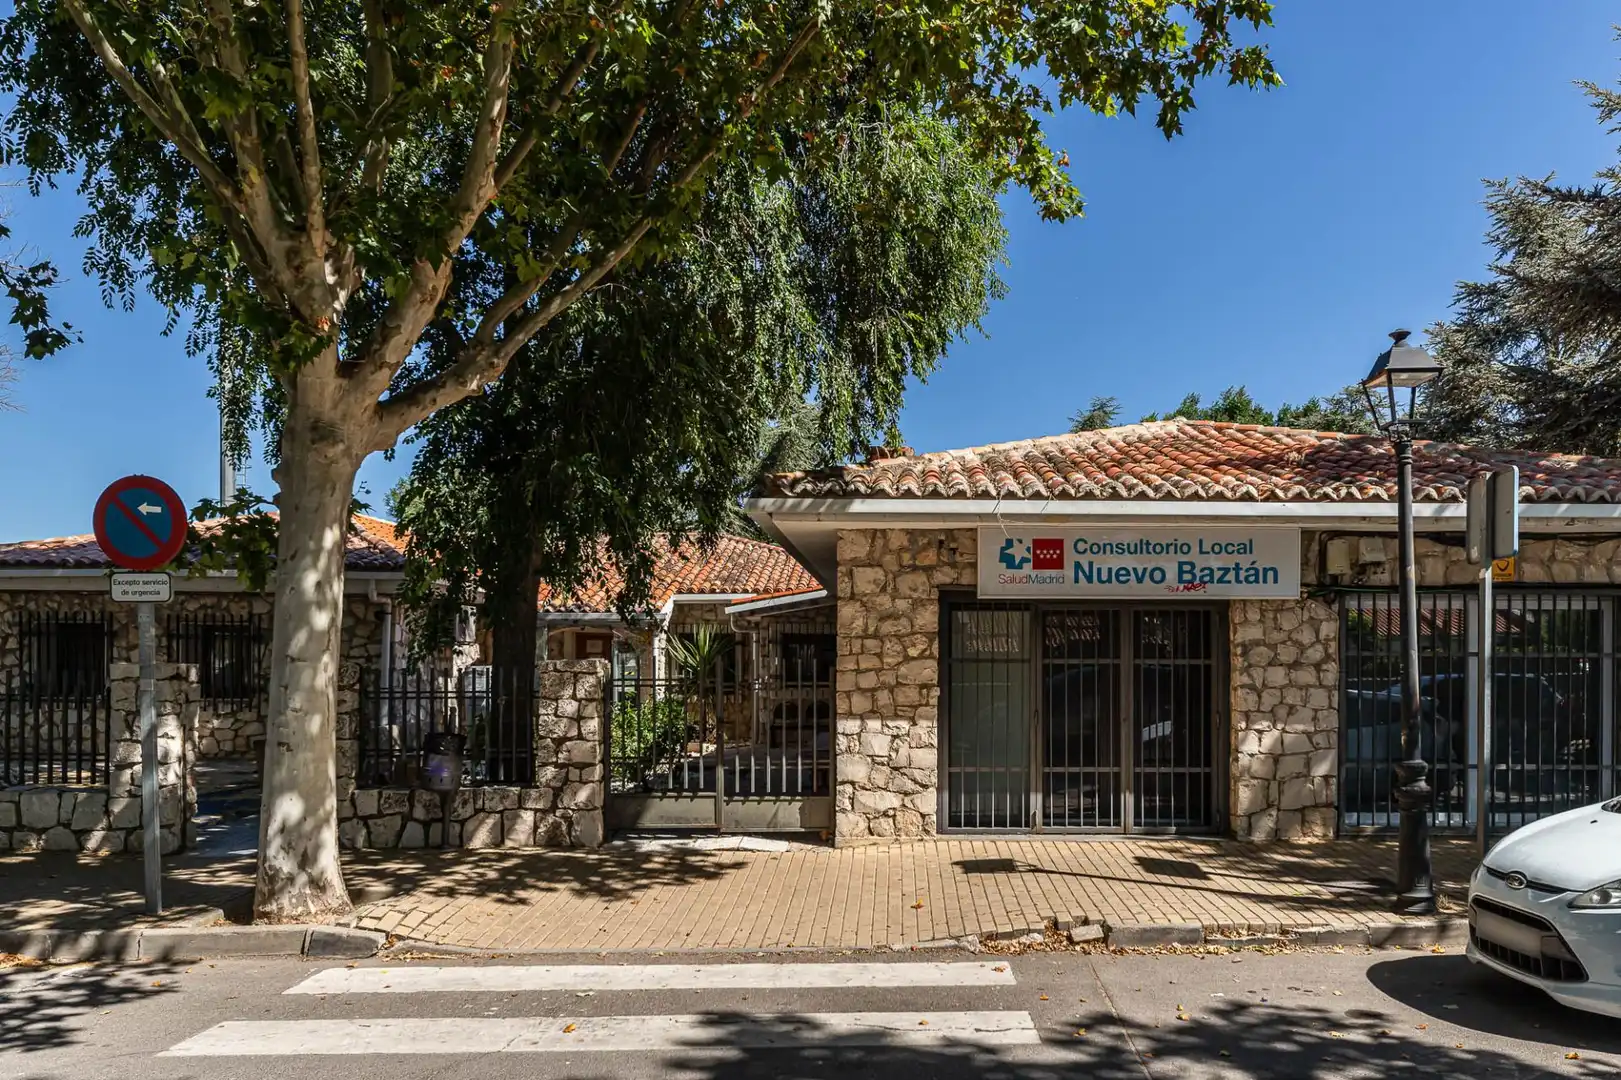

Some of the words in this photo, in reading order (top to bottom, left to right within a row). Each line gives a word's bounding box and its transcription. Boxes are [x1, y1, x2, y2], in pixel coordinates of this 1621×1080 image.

[1073, 538, 1192, 555] Consultorio
[1198, 538, 1253, 555] Local
[1073, 560, 1167, 585] Nuevo
[1177, 560, 1279, 585] Baztán
[141, 578, 168, 586] servicio
[131, 589, 160, 597] urgencia
